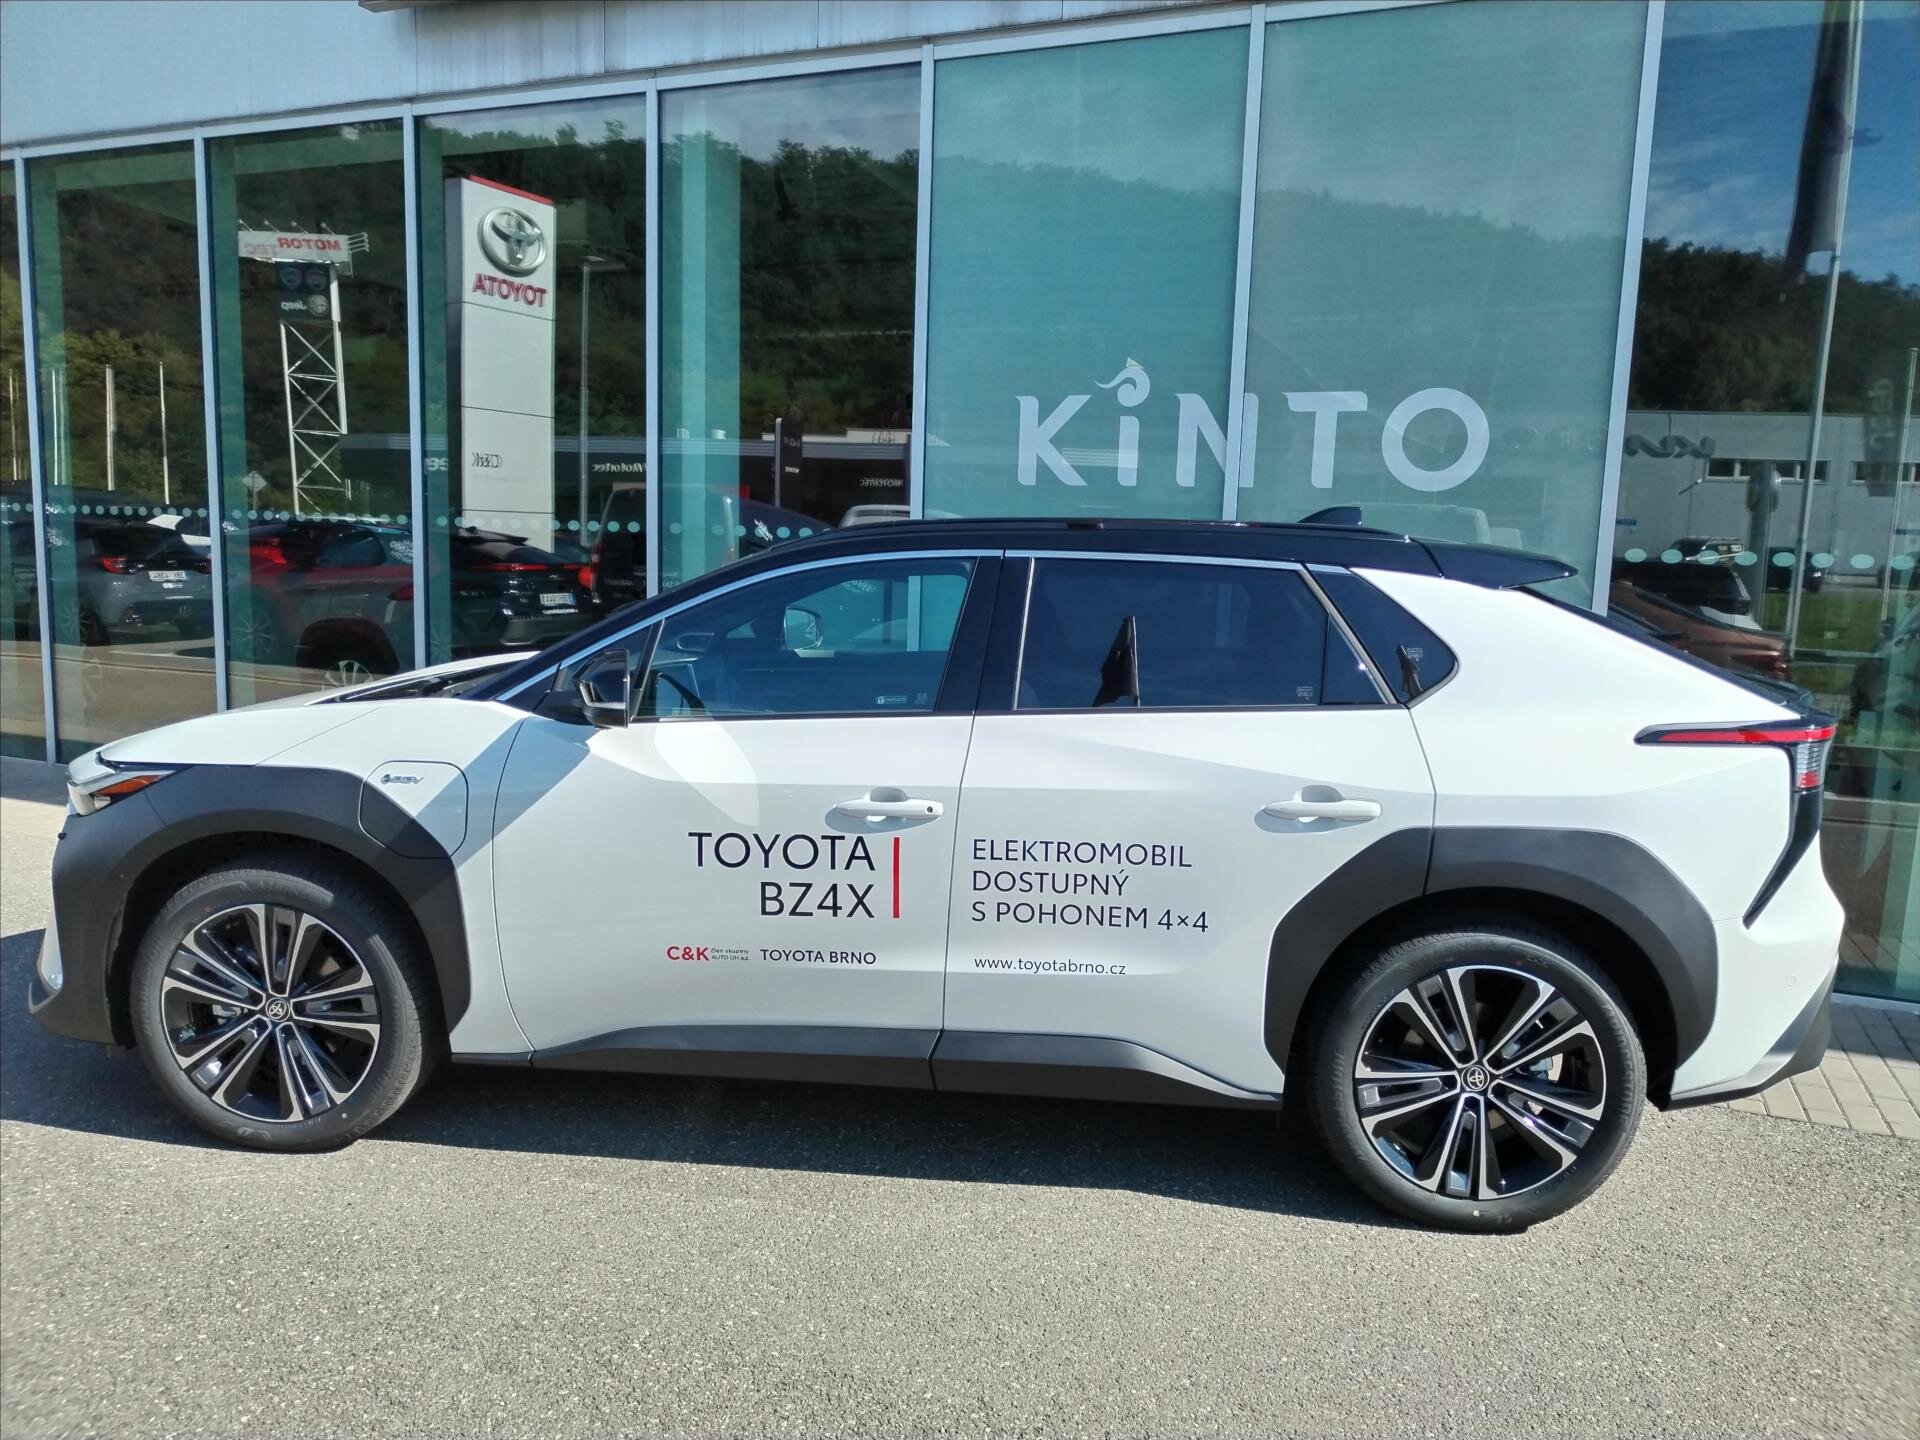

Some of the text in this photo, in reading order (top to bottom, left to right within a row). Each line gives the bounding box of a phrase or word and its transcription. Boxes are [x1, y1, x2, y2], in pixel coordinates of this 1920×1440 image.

[688, 832, 876, 871] TOYOTA
[973, 839, 1192, 867] ELEKTROMOBIL
[972, 869, 1129, 896] DOSTUPNÝ
[760, 881, 875, 918] BZ4X
[971, 901, 986, 922] S
[996, 902, 1148, 929] POHONEM
[666, 946, 710, 961] C&K
[760, 949, 877, 964] TOYOTA BRNO
[973, 958, 1126, 975] www.toyotabrno.cz
